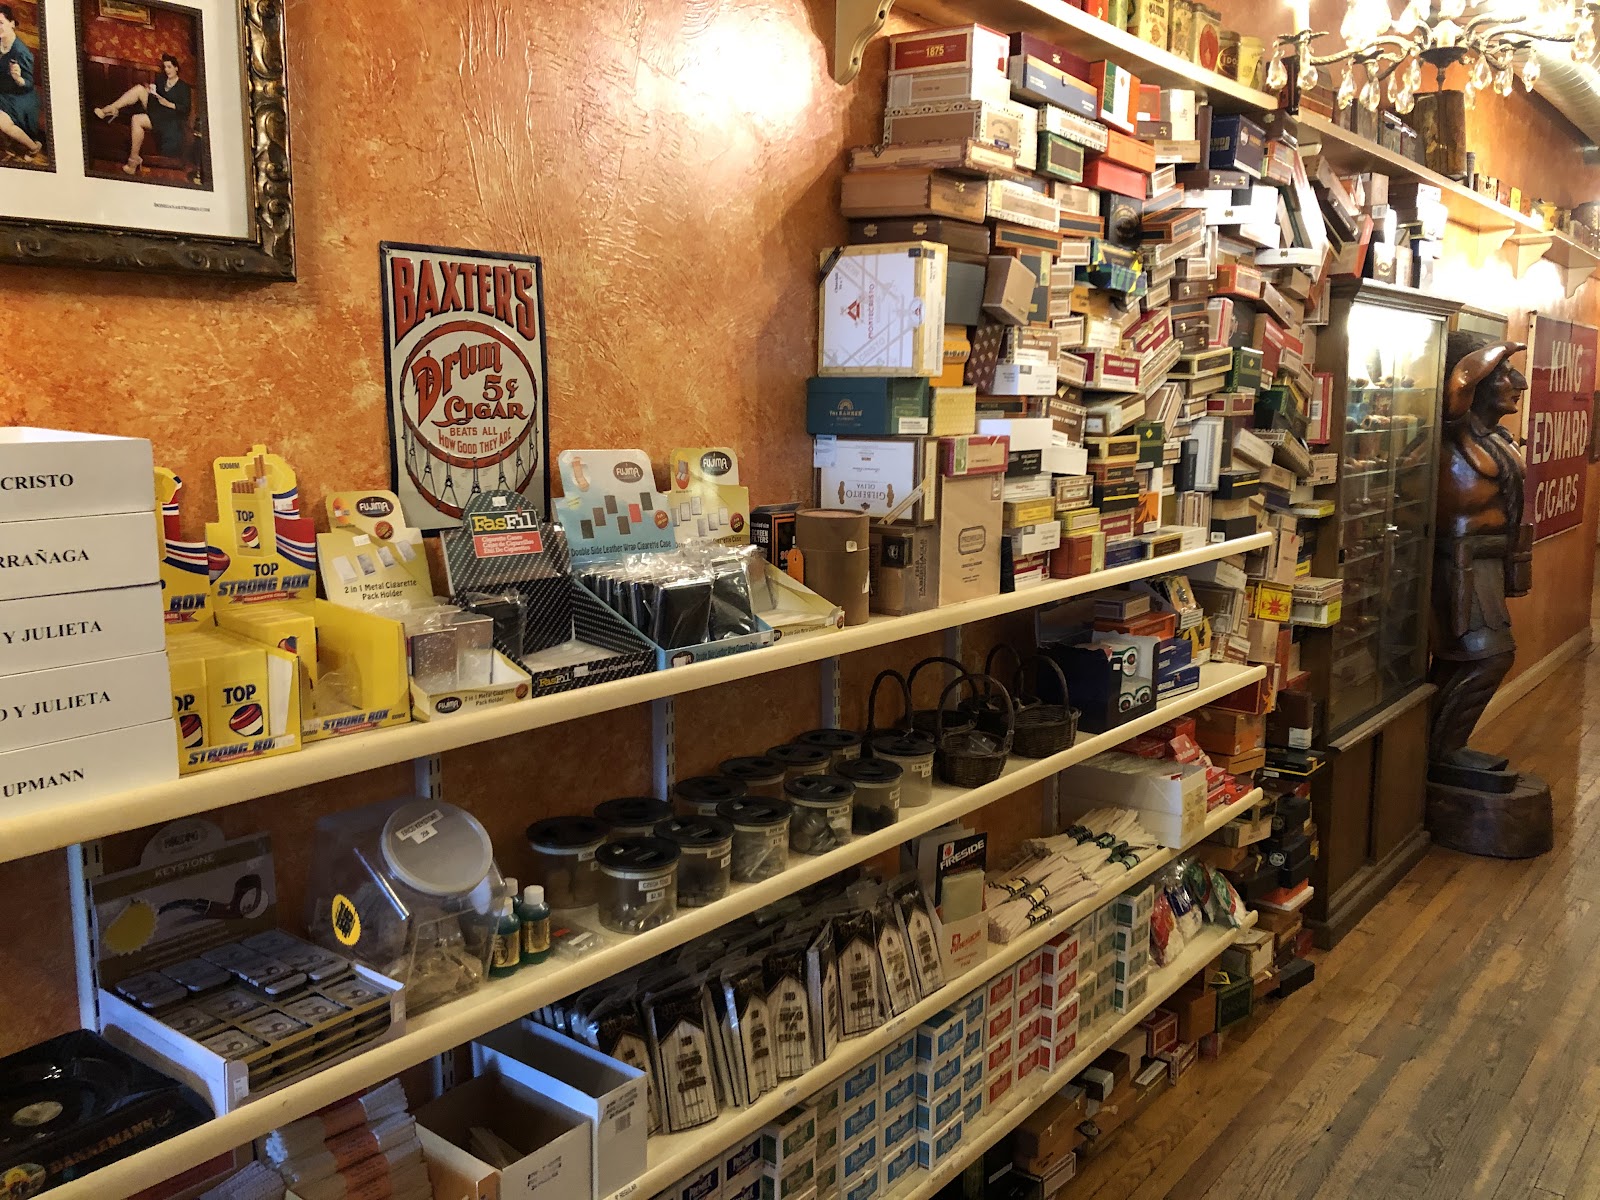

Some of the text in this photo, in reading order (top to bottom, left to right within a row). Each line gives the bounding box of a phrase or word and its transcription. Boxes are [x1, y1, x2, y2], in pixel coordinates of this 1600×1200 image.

[926, 46, 944, 57] 1875
[391, 257, 536, 349] BAXTER'S
[1549, 340, 1584, 393] KING
[411, 342, 503, 427] Drum
[438, 427, 511, 454] HOW GOOD THEY ARE
[450, 427, 497, 436] BEATS ALL
[1532, 409, 1588, 465] EDWARD
[1, 474, 73, 490] CRISTO
[846, 489, 886, 500] GILBERTO
[1534, 473, 1579, 523] CIGARS
[236, 510, 254, 521] TOP
[472, 512, 536, 531] FasFil
[571, 548, 590, 557] Double
[591, 546, 602, 554] Side
[603, 545, 622, 554] Leather
[624, 542, 636, 552] Wrap
[660, 540, 671, 549] Case
[254, 563, 279, 576] TOP
[218, 574, 310, 596] STRONG BOX
[344, 586, 349, 594] 2
[364, 582, 384, 591] Metal
[386, 580, 417, 589] Cigarette
[362, 590, 403, 600] Pack Holder
[170, 594, 206, 611] BOX
[3, 621, 102, 644] Y JULIETA
[13, 705, 26, 718] Y
[32, 691, 111, 715] JULIETA
[223, 684, 257, 704] TOP
[323, 713, 365, 730] STRONG
[368, 709, 390, 720] BOX
[188, 743, 250, 765] STRONG
[253, 737, 275, 751] BO
[3, 768, 84, 797] UPMANN
[154, 854, 215, 877] KEYSTONE
[940, 840, 984, 870] FIRESIDE
